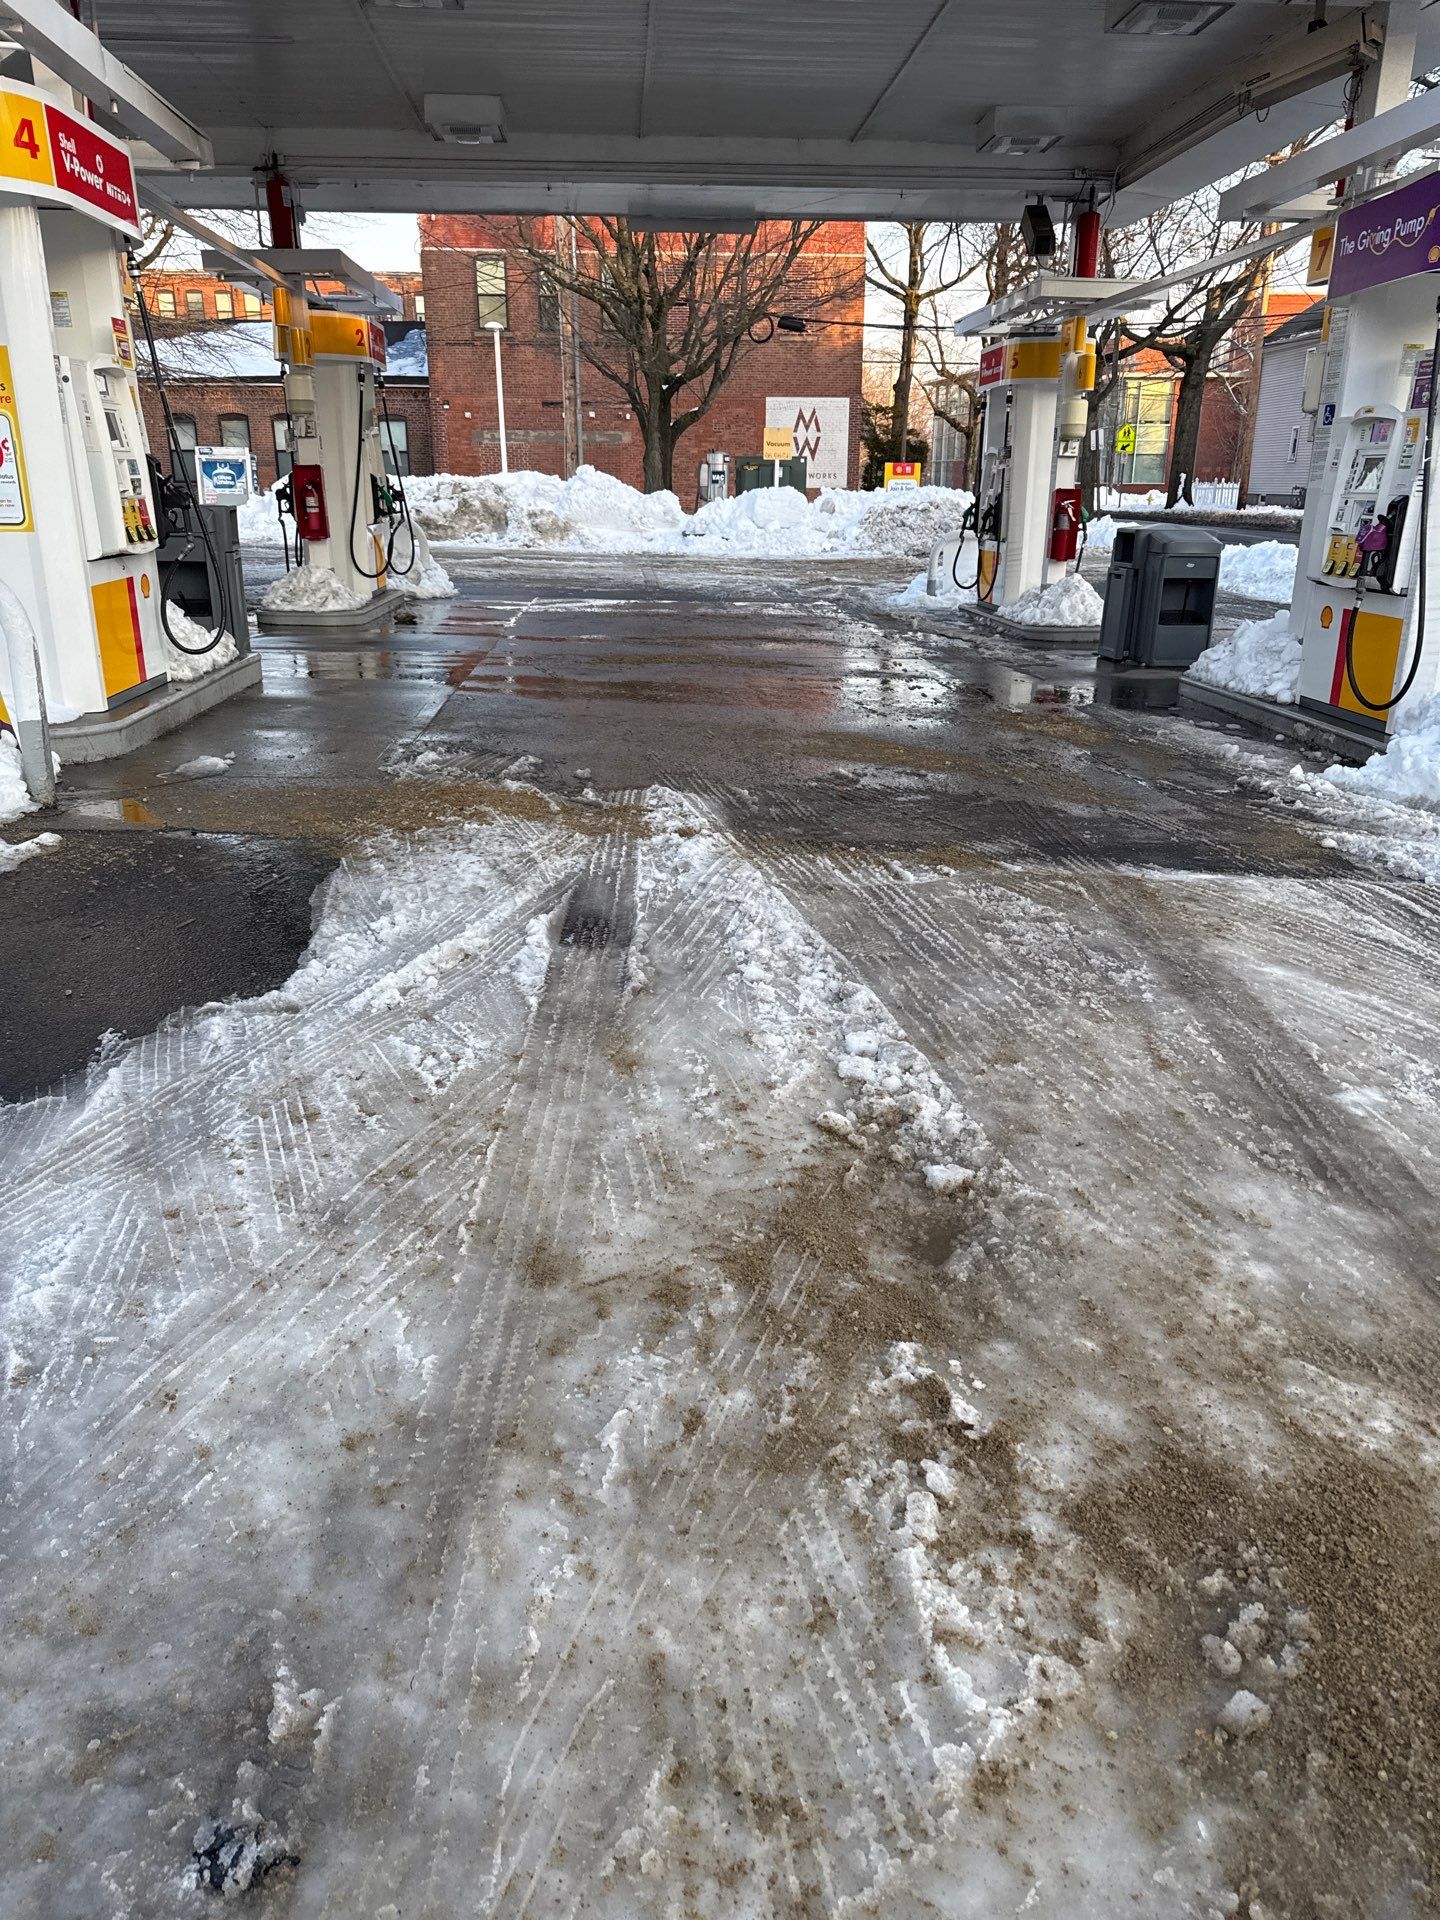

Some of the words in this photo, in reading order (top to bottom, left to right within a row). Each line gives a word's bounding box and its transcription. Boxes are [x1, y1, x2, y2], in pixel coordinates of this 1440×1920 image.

[13, 118, 40, 159] 4
[58, 132, 77, 155] Shell
[61, 150, 104, 191] V-Power
[106, 181, 131, 206] NITRO+
[1340, 235, 1355, 256] The
[1357, 226, 1391, 252] Giving
[1394, 215, 1425, 240] Pump
[1315, 236, 1332, 271] 7
[305, 336, 312, 359] 2
[355, 328, 365, 347] 2
[1011, 351, 1019, 370] 5
[793, 406, 822, 433] M
[766, 440, 791, 448] Vacuum
[793, 436, 822, 462] W
[808, 472, 838, 480] WORKS
